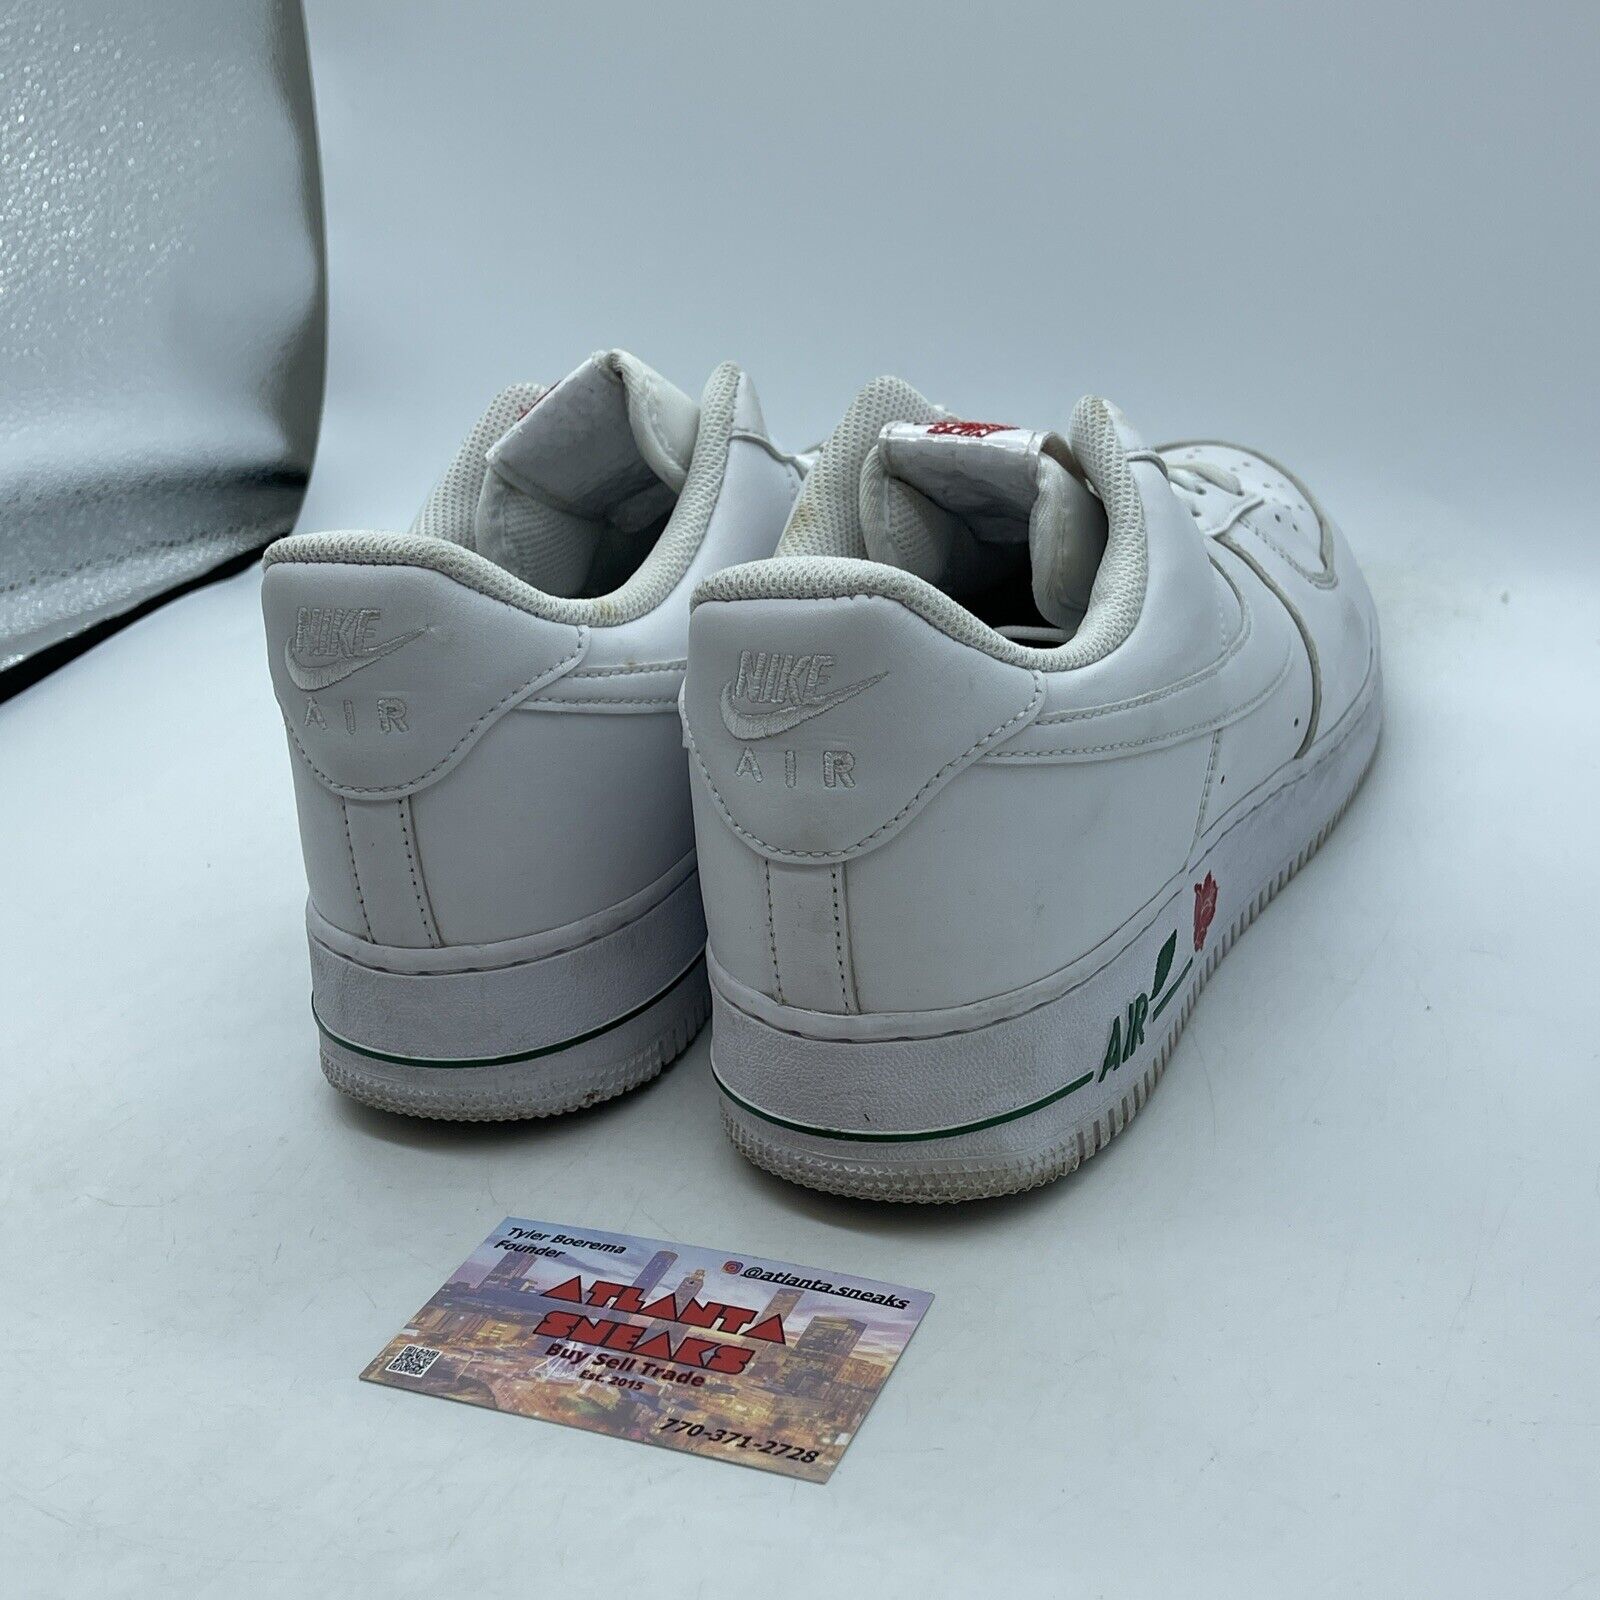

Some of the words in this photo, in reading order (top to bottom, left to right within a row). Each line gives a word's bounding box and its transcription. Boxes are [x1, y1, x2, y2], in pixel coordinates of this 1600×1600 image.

[296, 606, 381, 657] NIKE
[734, 650, 836, 704] NIKE
[304, 696, 409, 735] AIR
[735, 747, 856, 788] AIR
[1098, 992, 1149, 1082] AIR
[494, 1239, 566, 1258] Founder
[507, 1227, 551, 1241] Tyler
[549, 1234, 627, 1254] Boerema
[540, 1275, 786, 1345] ATLANTA
[741, 1266, 910, 1310] @atlanta.sneaks
[533, 1310, 756, 1375] SNEAKS
[545, 1342, 590, 1365] Buy
[591, 1353, 637, 1372] Sell
[640, 1361, 706, 1387] Trade
[579, 1369, 604, 1383] Est.
[607, 1375, 645, 1391] 2015
[660, 1417, 820, 1464] 770-371-2728
